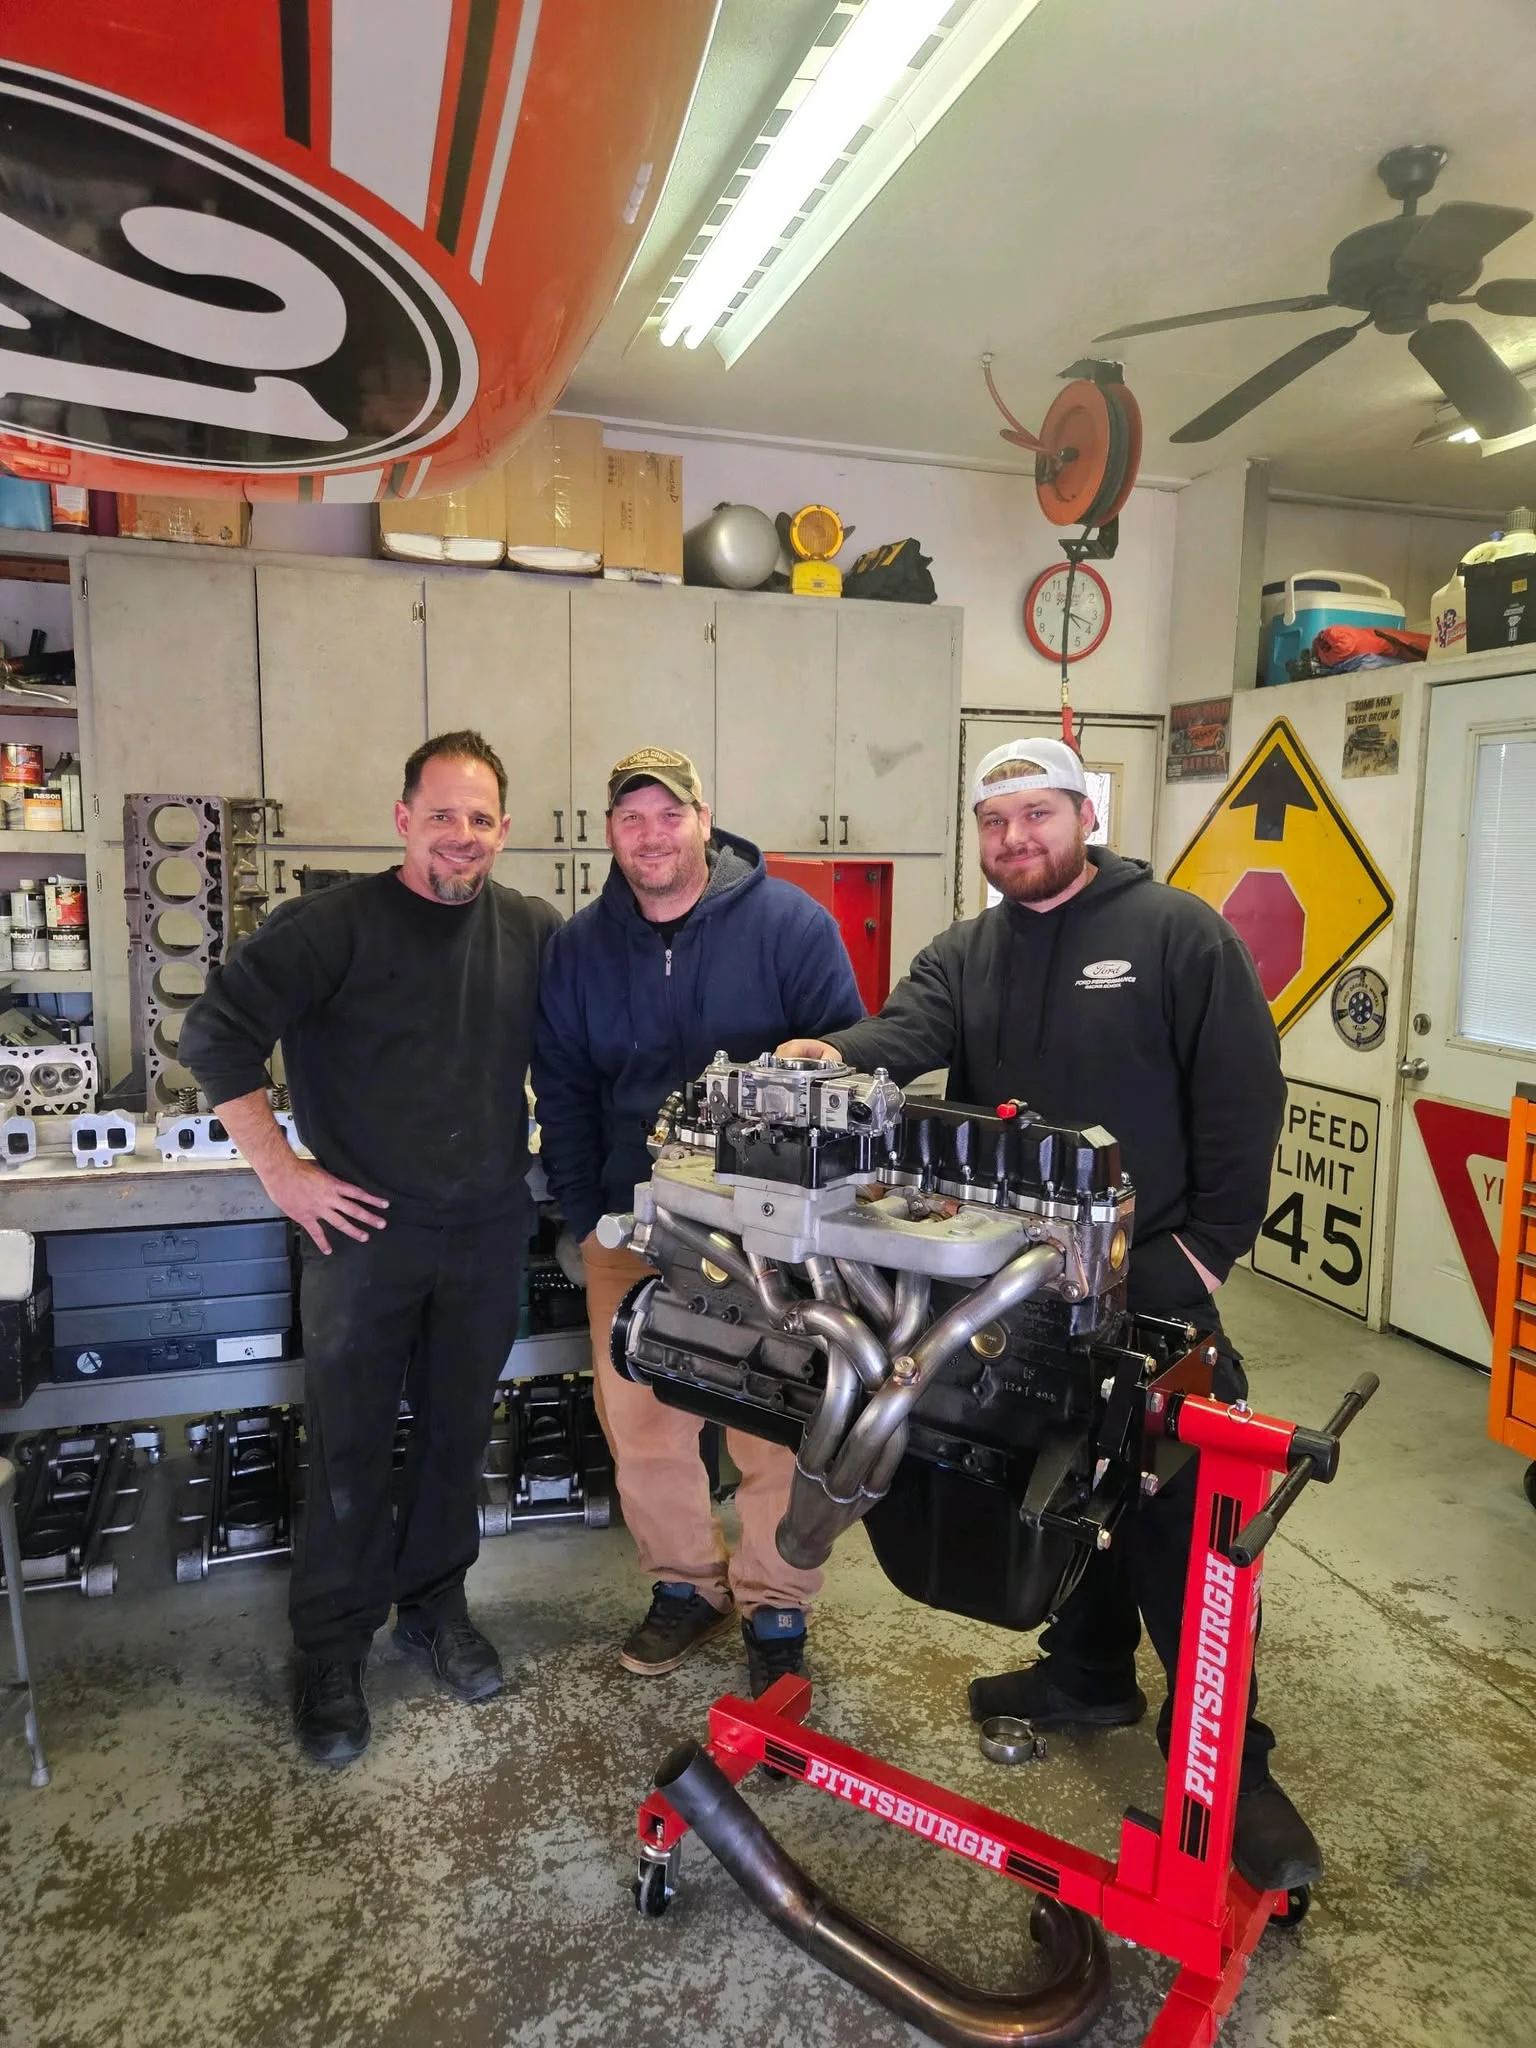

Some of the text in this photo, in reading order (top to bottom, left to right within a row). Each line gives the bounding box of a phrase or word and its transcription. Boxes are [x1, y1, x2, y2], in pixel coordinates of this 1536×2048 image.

[1052, 580, 1061, 590] 11
[1081, 582, 1086, 592] 1
[1041, 591, 1052, 602] 10
[1088, 593, 1095, 604] 2
[1036, 606, 1043, 617] 9
[1091, 610, 1098, 620] 3
[1039, 622, 1045, 633] 8
[1085, 624, 1091, 635] 4
[1049, 634, 1055, 645] 7
[1074, 636, 1081, 647] 5
[1346, 709, 1400, 725] NEVER GROW UP
[629, 751, 650, 763] CADES
[1093, 965, 1121, 975] Ford
[1289, 1104, 1368, 1153] PEED
[1277, 1144, 1355, 1195] LIMIT
[1262, 1192, 1363, 1286] 45
[1185, 1552, 1236, 1806] PITTSBURGH
[807, 1758, 1006, 1869] PITTSBURGH
